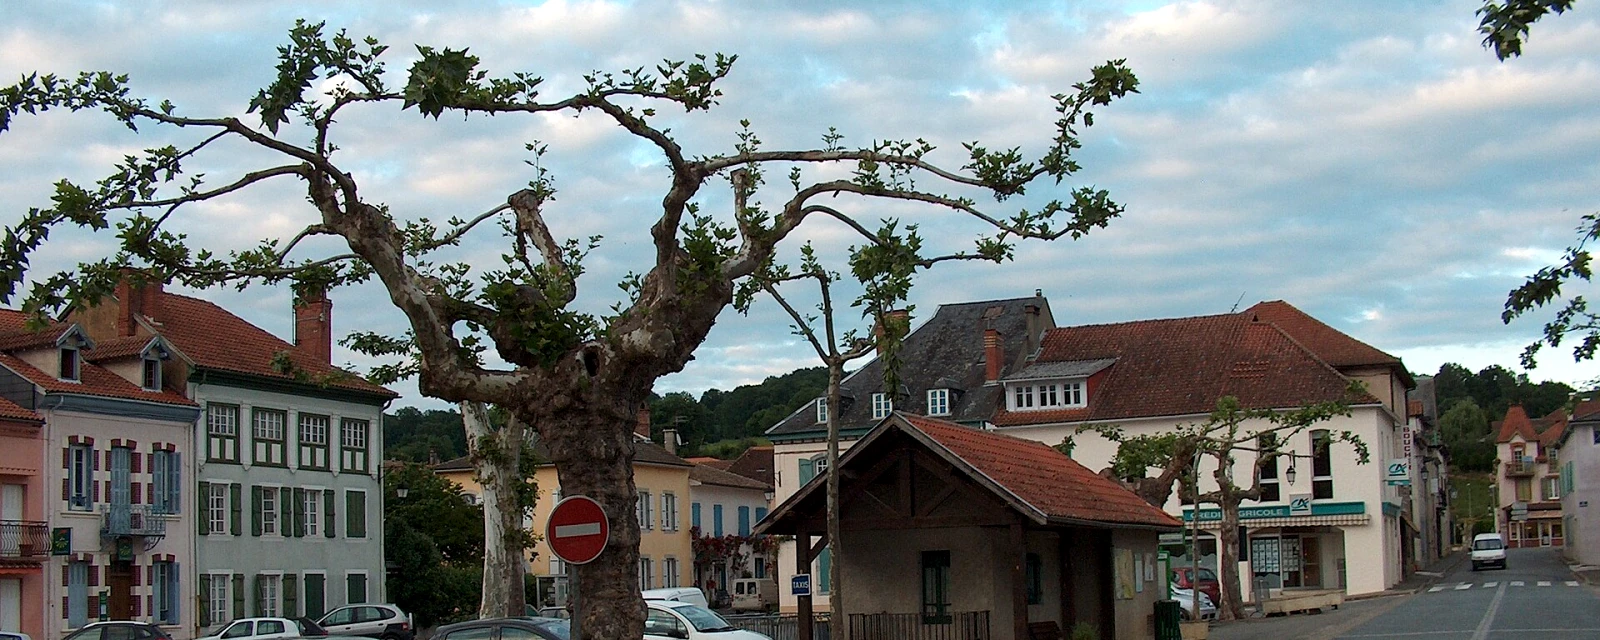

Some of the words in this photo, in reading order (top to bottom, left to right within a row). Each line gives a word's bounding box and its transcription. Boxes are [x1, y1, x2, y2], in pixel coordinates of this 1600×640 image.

[1190, 510, 1223, 519] CREDI
[1237, 508, 1284, 518] GRICOLE
[793, 581, 809, 589] TAXIS
